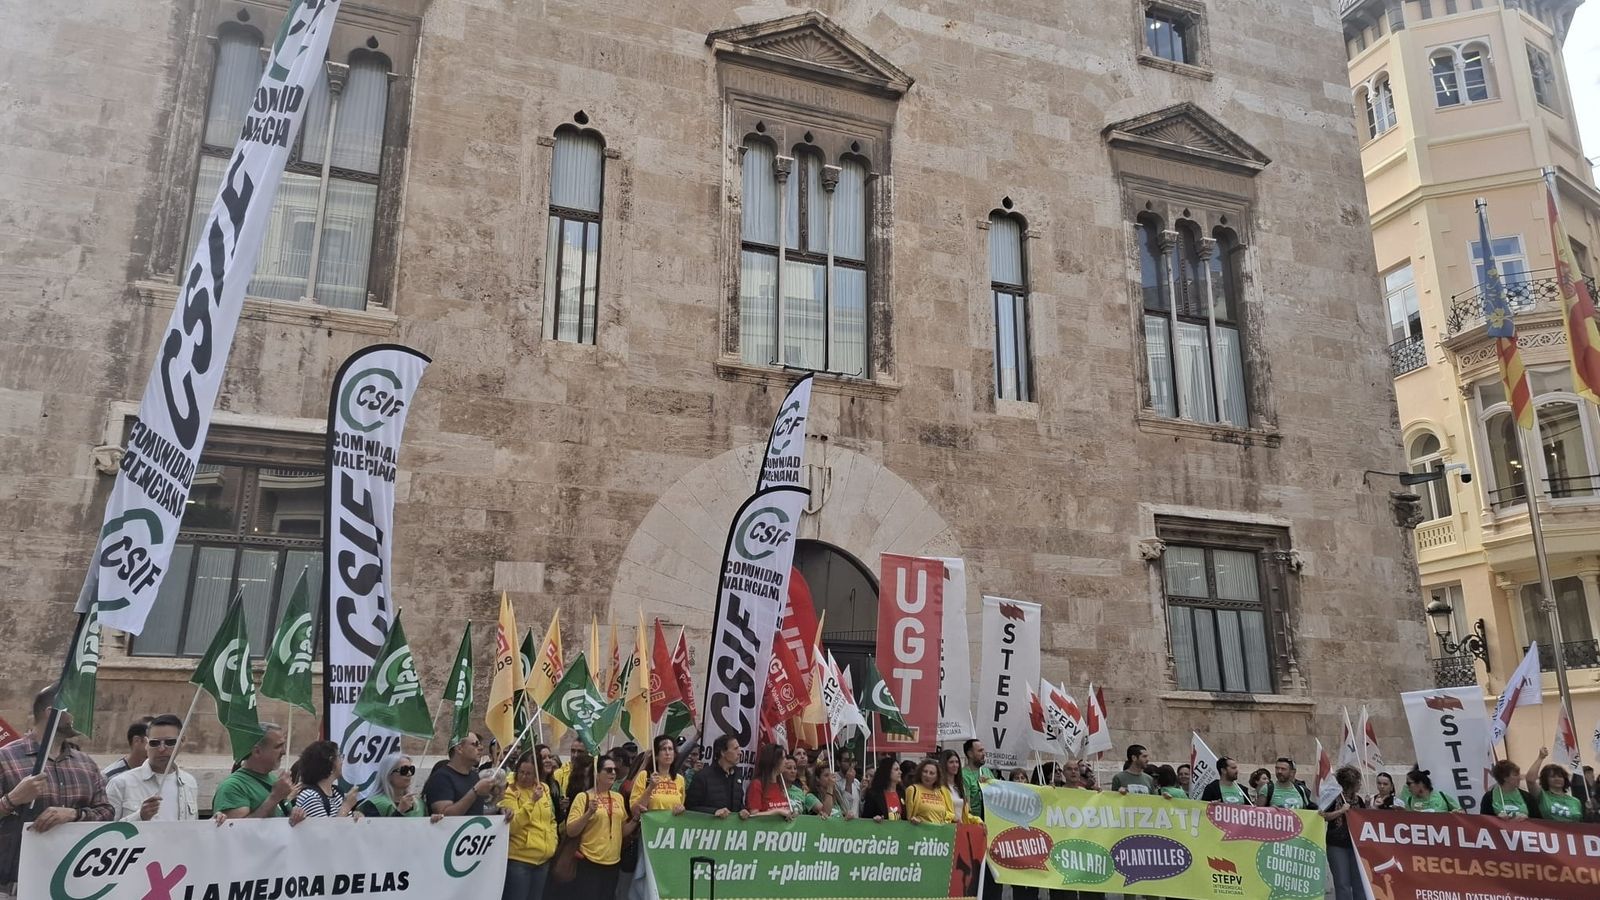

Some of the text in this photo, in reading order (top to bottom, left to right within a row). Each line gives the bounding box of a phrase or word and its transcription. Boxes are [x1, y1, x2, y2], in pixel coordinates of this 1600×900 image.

[356, 385, 404, 417] CSIF
[749, 521, 791, 548] CSIF
[100, 536, 162, 595] CSIF
[336, 471, 387, 660] CSIF
[892, 566, 927, 715] UGT
[711, 592, 761, 748] CSIF
[769, 653, 789, 683] GT
[992, 623, 1016, 749] STEPV
[1046, 805, 1200, 838] MOBILITZA'T!
[455, 835, 496, 856] CSIF
[648, 827, 676, 849] JA
[724, 830, 747, 851] HA
[753, 830, 806, 852] PROU!
[814, 833, 899, 855] -burocràcia
[908, 839, 950, 856] -ràtios
[1360, 821, 1451, 847] ALCEM
[1458, 826, 1497, 850] LA
[1500, 829, 1560, 854] VEU
[1568, 833, 1577, 856] I
[72, 847, 146, 878] CSIF
[1054, 849, 1106, 875] +SALARI
[1114, 849, 1185, 867] +PLANTILLES
[1266, 855, 1321, 880] EDUCATIUS
[1273, 843, 1316, 864] CENTRES
[768, 860, 840, 885] +plantilla
[850, 862, 922, 883] +valencià
[1212, 873, 1242, 886] STEPV
[1274, 873, 1310, 894] DIGNES
[1412, 856, 1600, 885] RECLASSIFICACI
[228, 875, 325, 900] MEJORA
[331, 873, 366, 895] DE
[369, 871, 410, 893] LAS
[1415, 888, 1461, 900] PERSONAL
